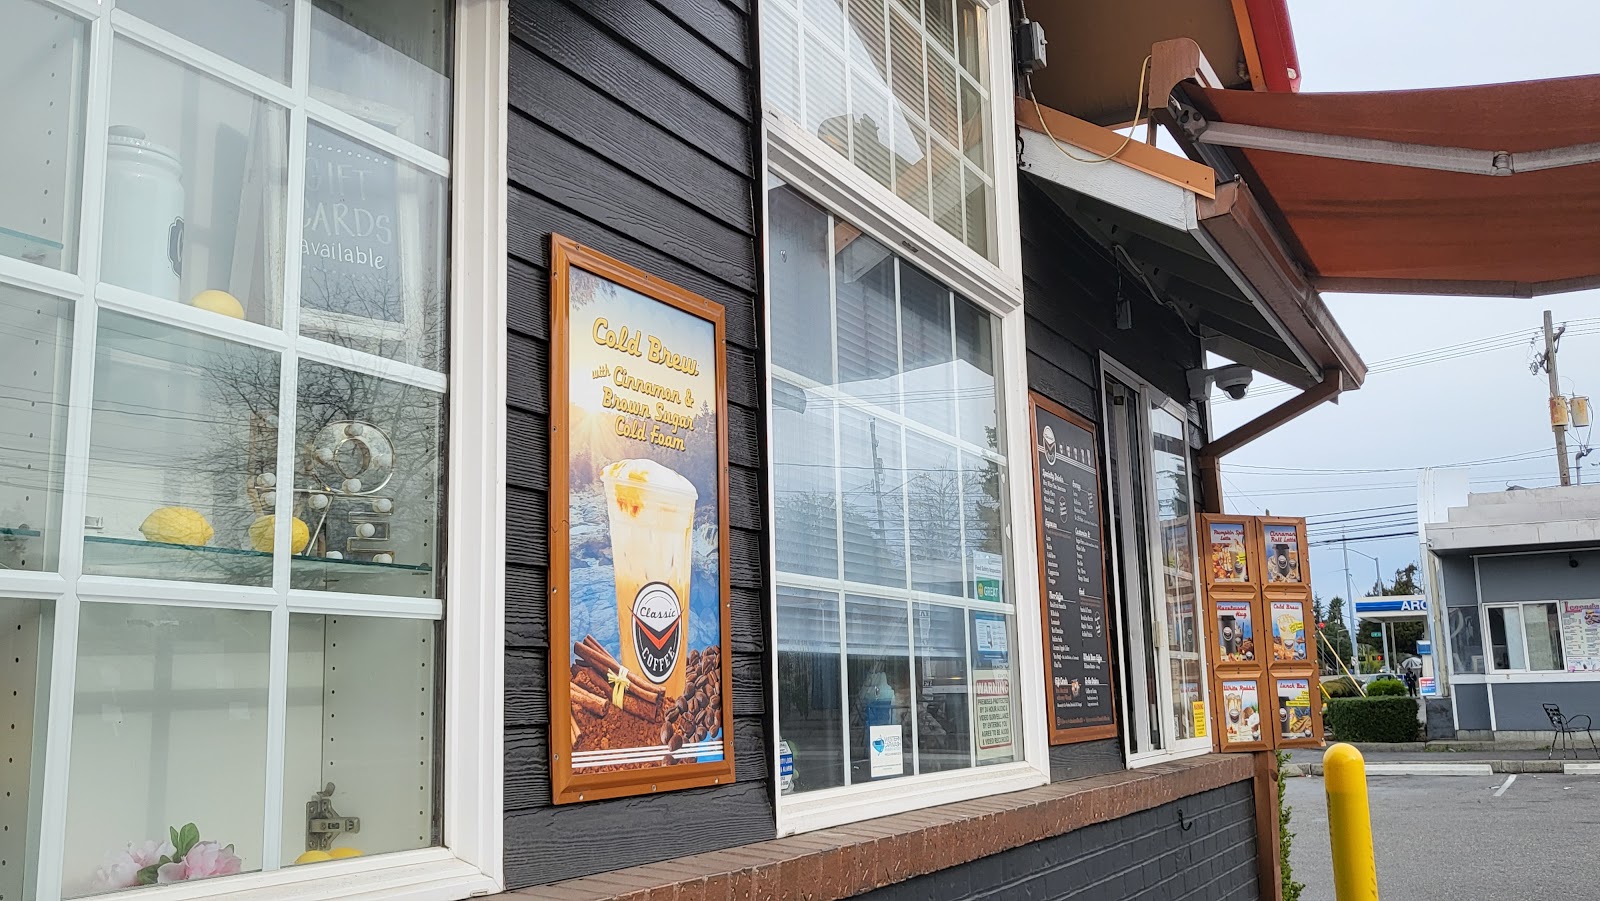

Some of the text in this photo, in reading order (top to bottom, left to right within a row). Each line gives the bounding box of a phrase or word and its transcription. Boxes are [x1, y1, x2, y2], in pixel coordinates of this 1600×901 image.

[301, 238, 386, 270] available
[592, 317, 699, 376] Cold Brew
[592, 363, 695, 409] with Cinnamon &
[602, 386, 695, 434] Brown Sugar
[615, 415, 686, 452] Cold Foam
[983, 586, 999, 597] GREAT
[640, 606, 676, 619] Classic
[641, 646, 676, 673] COFFEE
[977, 682, 1008, 694] WARNING
